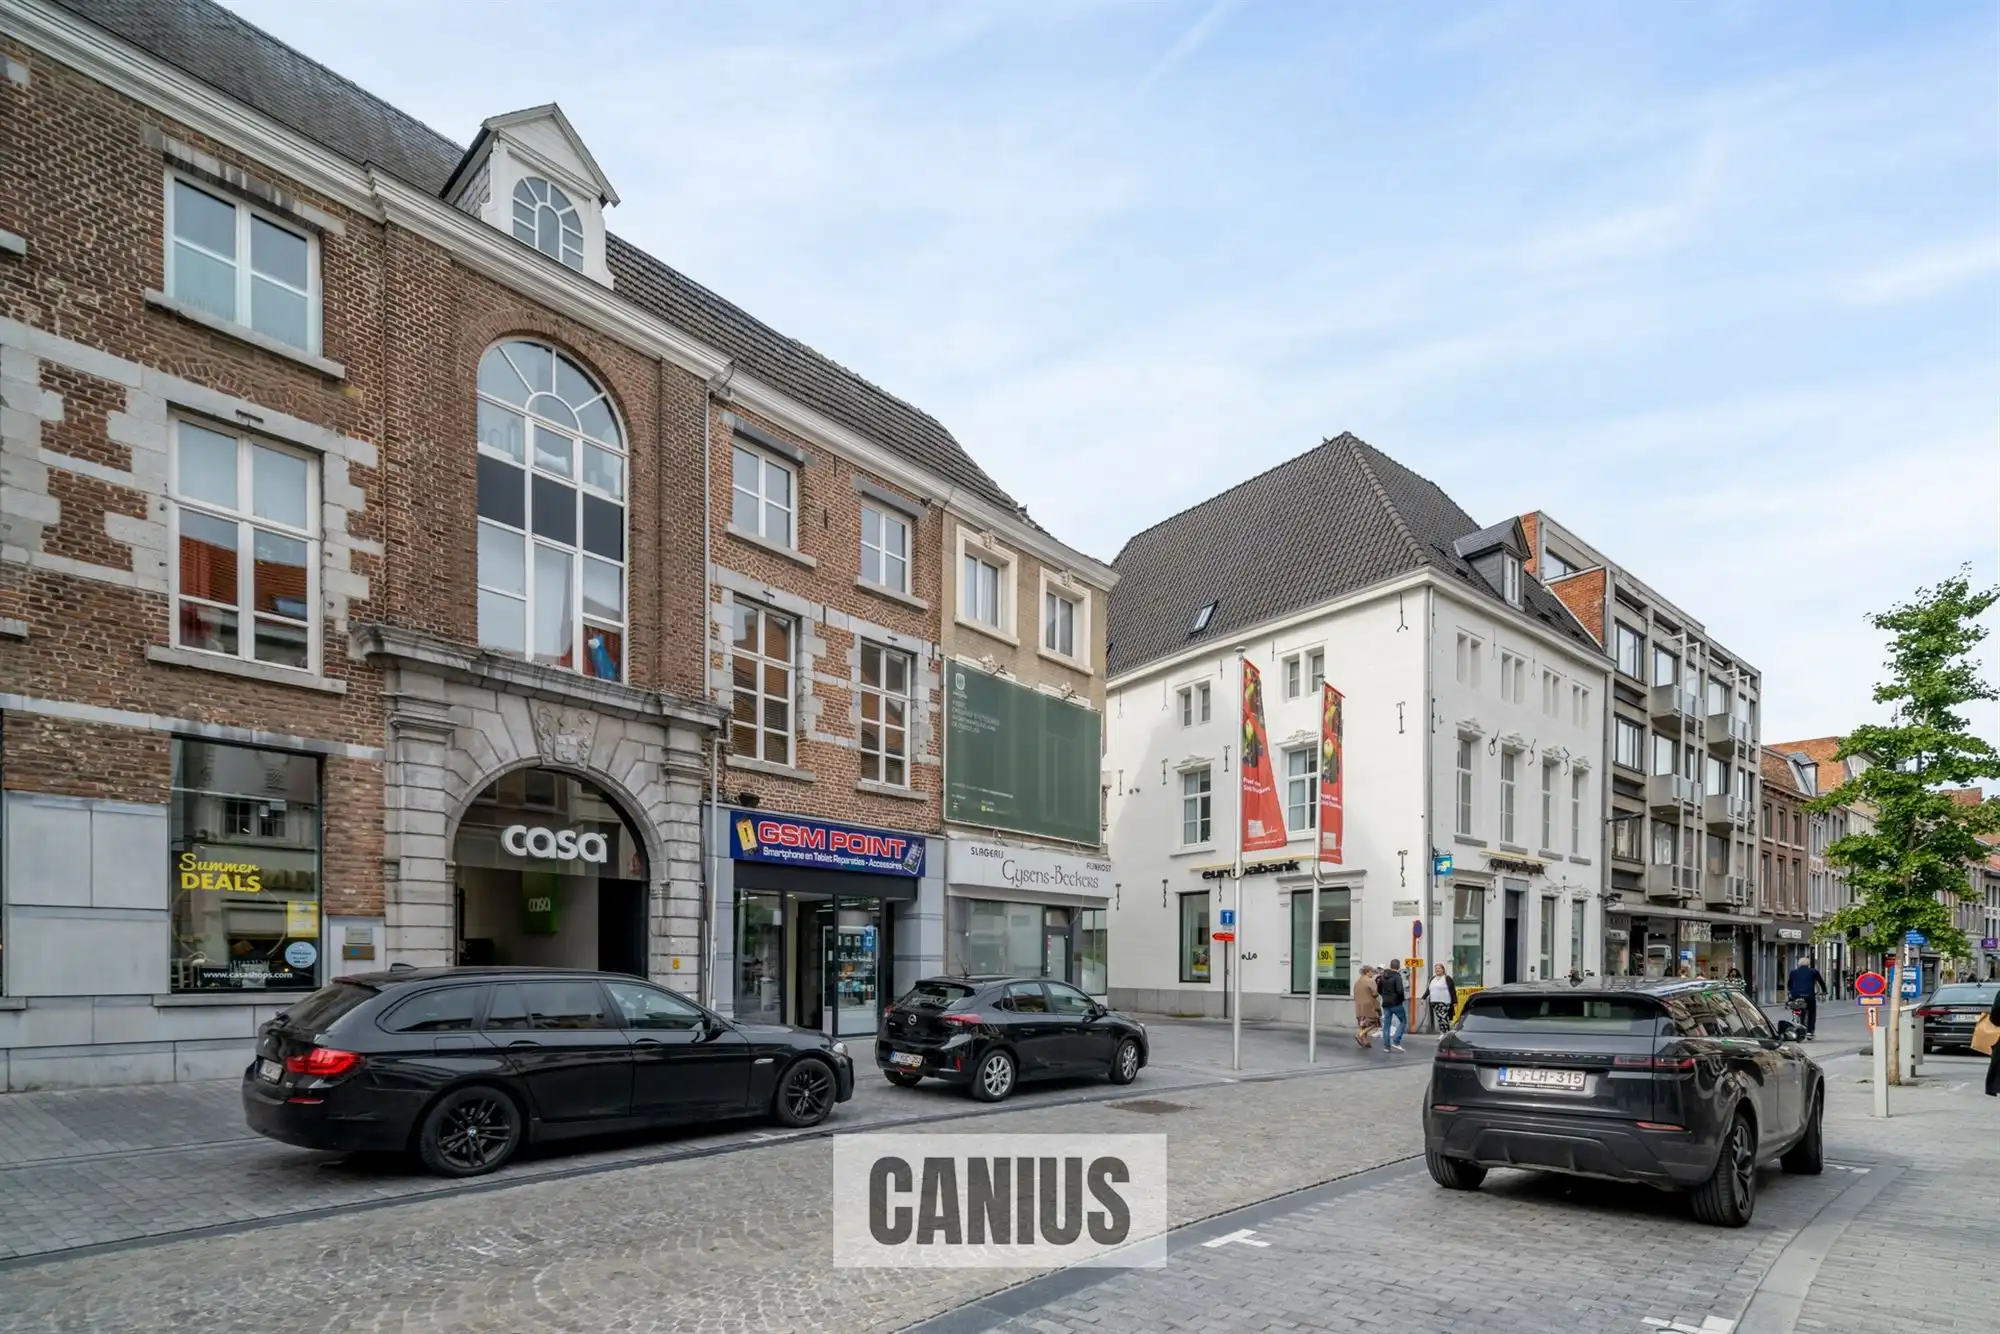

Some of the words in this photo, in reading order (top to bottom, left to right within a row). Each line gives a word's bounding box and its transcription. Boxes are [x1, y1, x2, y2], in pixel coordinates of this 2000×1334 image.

[502, 824, 607, 863] casa
[758, 820, 825, 849] GSM
[829, 831, 907, 859] POINT
[763, 846, 804, 861] Smartphone
[805, 852, 814, 860] en
[814, 852, 833, 863] Tablet
[868, 858, 903, 870] Accessoires
[971, 846, 1004, 859] SLAGERIJ
[179, 853, 260, 873] Summer
[181, 872, 262, 892] DEALS
[203, 971, 294, 980] www.casashops.com
